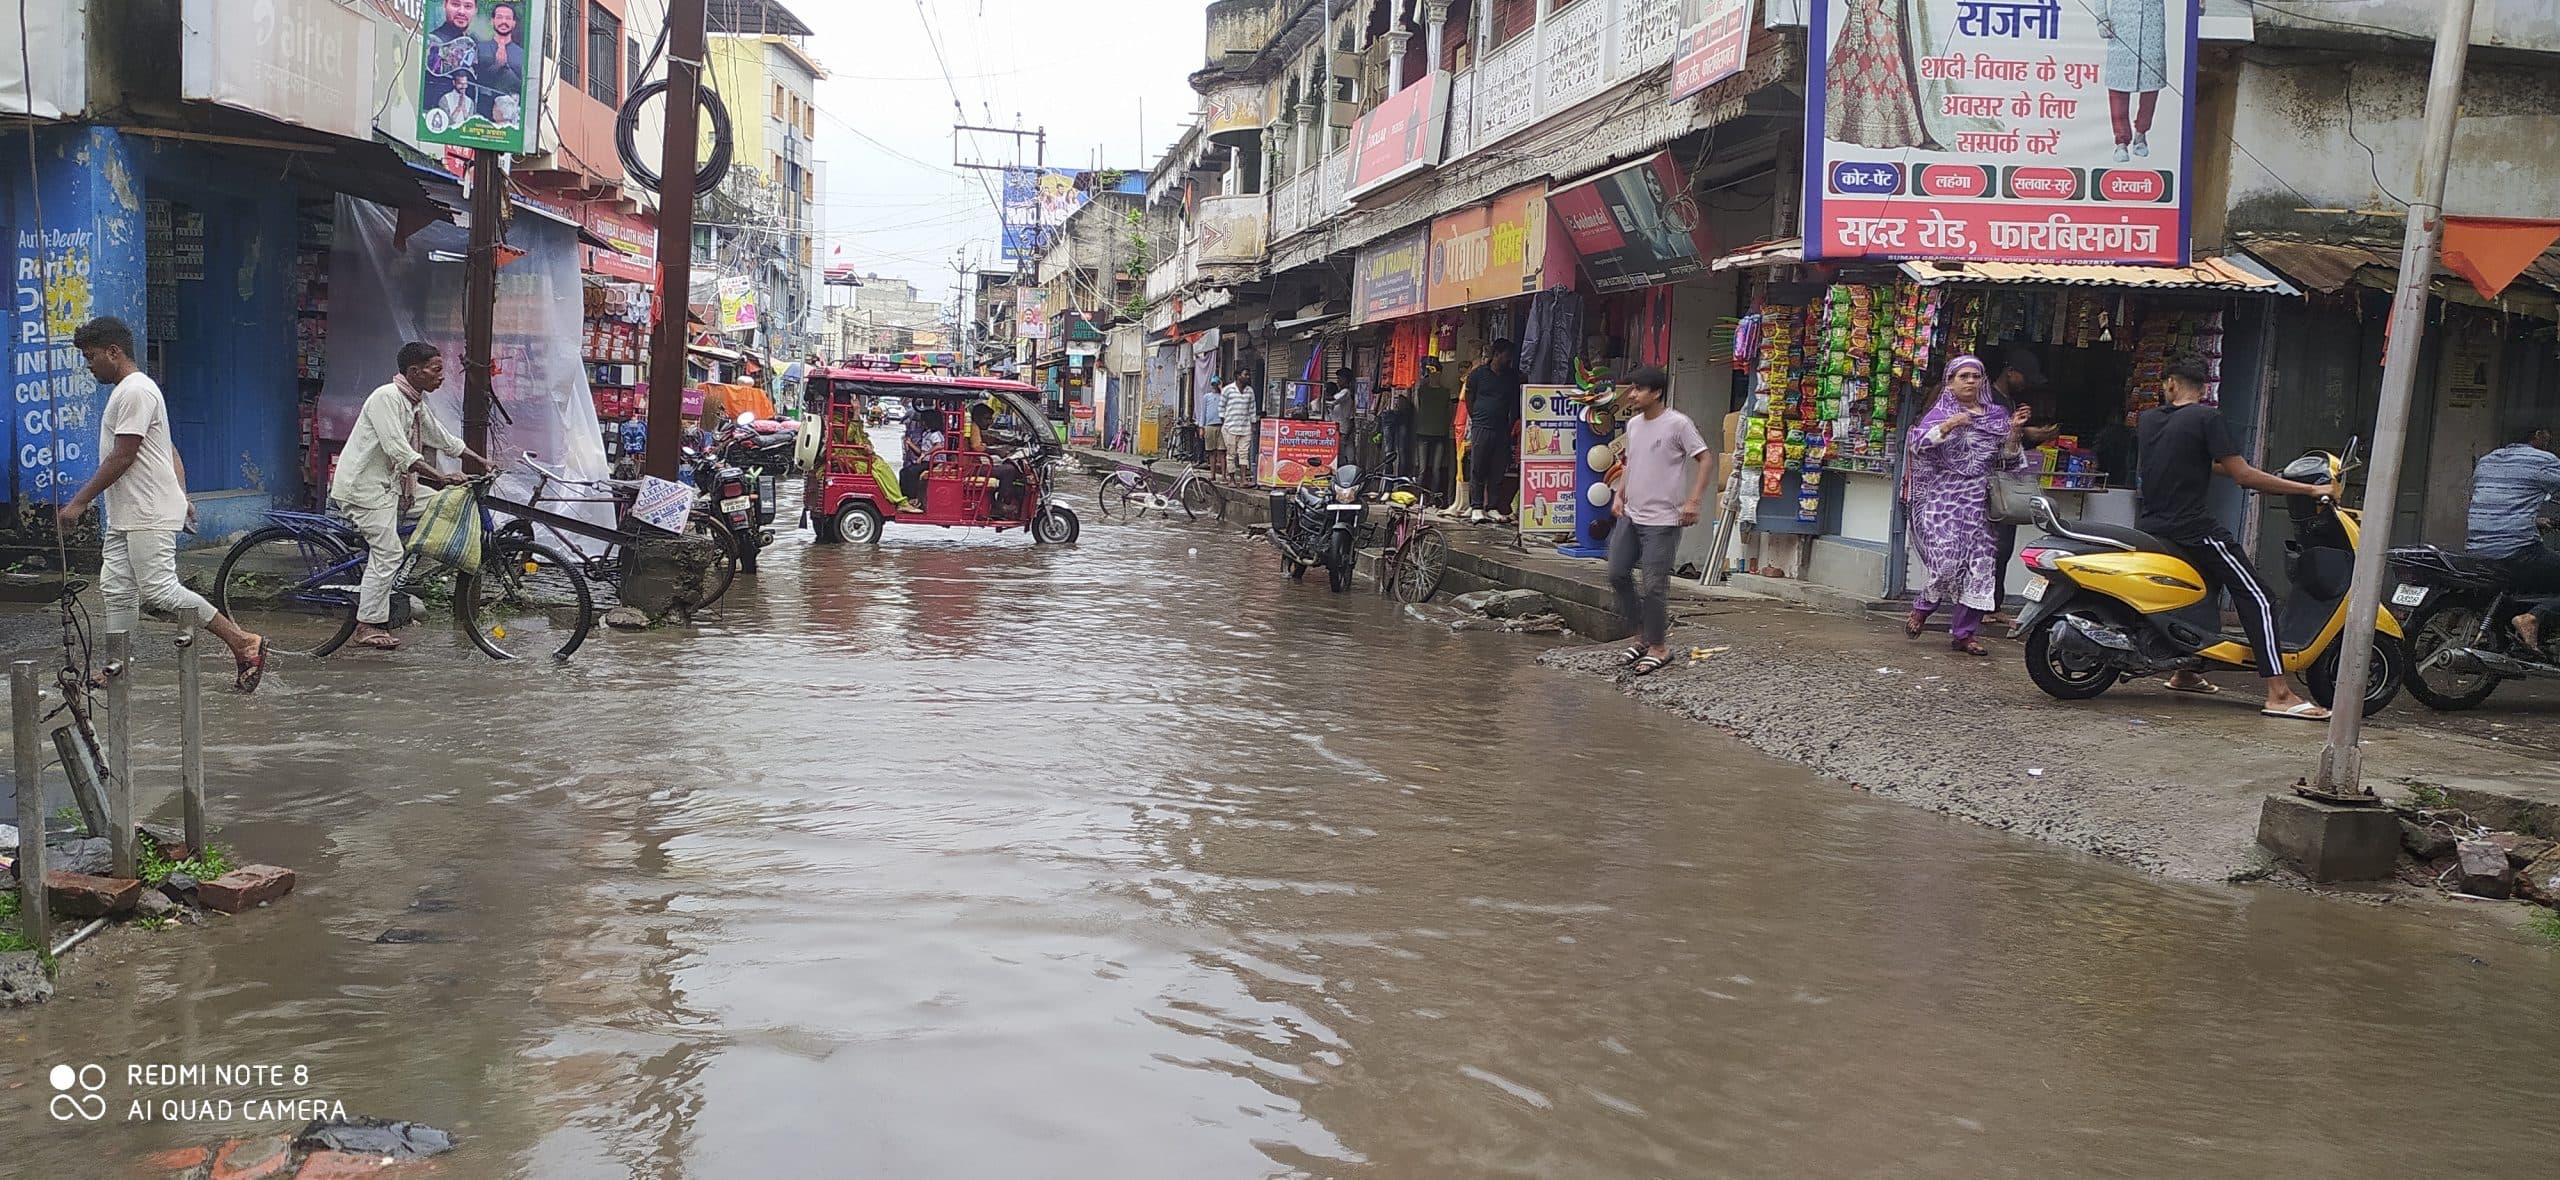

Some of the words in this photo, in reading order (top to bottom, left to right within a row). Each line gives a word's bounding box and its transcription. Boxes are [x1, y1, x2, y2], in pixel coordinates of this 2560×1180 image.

[280, 5, 344, 80] airtel
[1920, 53, 2028, 82] शादी-विवाह
[2036, 56, 2058, 82] के
[2063, 61, 2100, 89] शुभ
[1941, 95, 2005, 118] अवसर
[2011, 92, 2032, 118] के
[2039, 94, 2078, 120] लिए
[1956, 129, 2020, 154] सम्पर्क
[2025, 128, 2061, 155] करें
[1841, 169, 1893, 188] कोट-पेंट
[1934, 172, 1972, 190] लहंगा
[2014, 175, 2073, 193] सलवार-सूट
[2111, 177, 2153, 194] शेरवानी
[596, 219, 620, 238] BOMBAY
[619, 225, 638, 244] CLOTH
[637, 229, 655, 249] HOUSE
[1836, 215, 1909, 249] सदर
[1916, 208, 1978, 254] रोड,
[1988, 213, 2160, 254] फारबिसगंज
[1445, 223, 1491, 284] पोशाक
[24, 406, 88, 436] COPY
[20, 438, 82, 469] Cello
[642, 482, 671, 498] LEELA
[1527, 469, 1574, 490] साजन
[637, 485, 681, 508] COMPUTER
